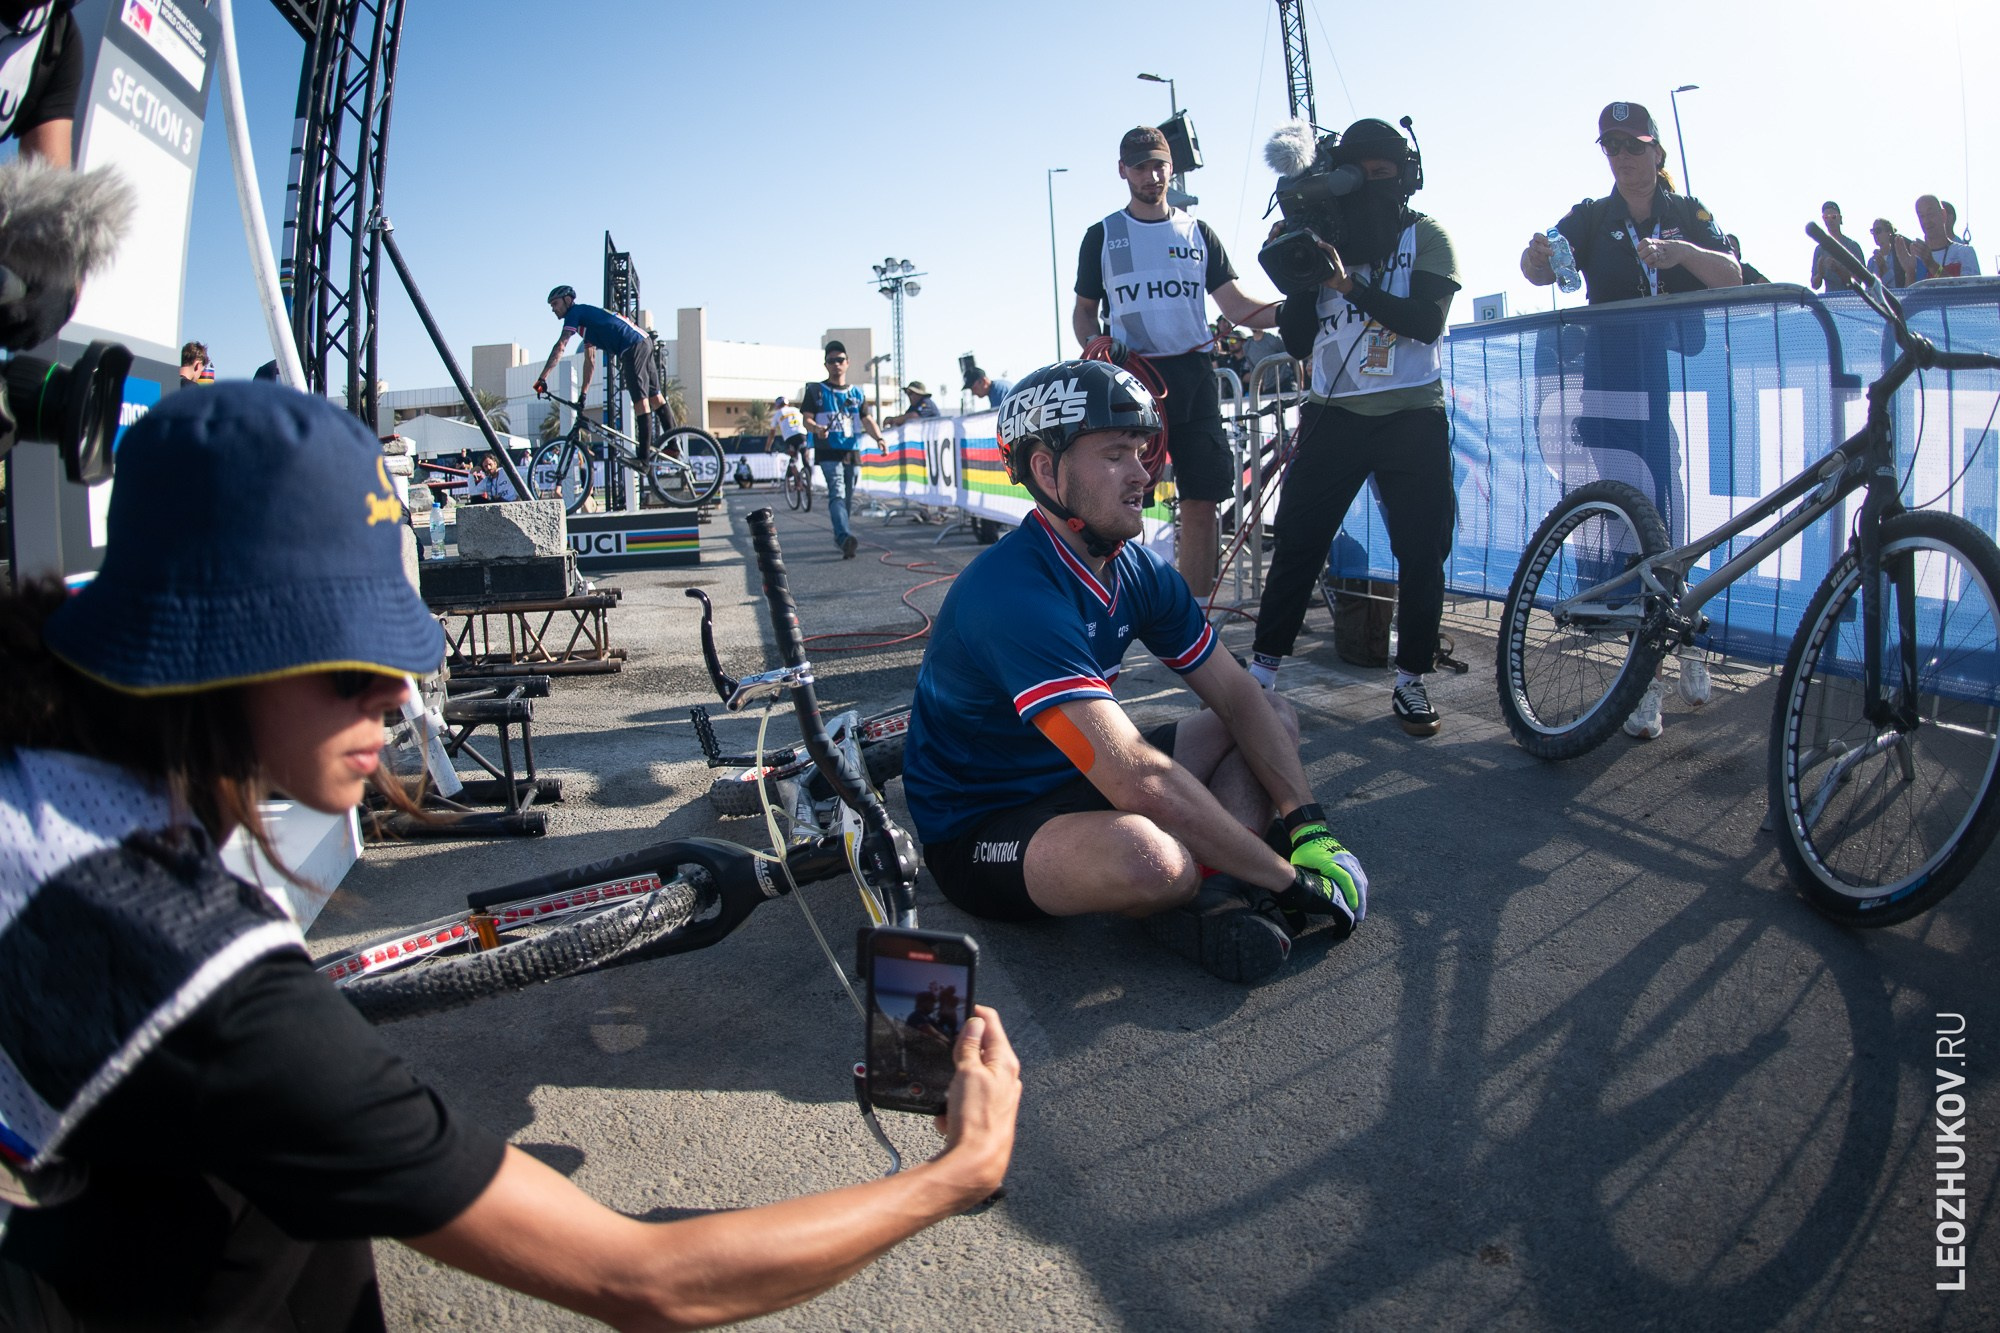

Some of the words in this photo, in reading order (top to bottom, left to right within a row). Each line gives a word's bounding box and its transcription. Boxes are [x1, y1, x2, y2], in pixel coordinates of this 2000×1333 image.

[108, 67, 183, 148] SECTION
[182, 126, 193, 155] 3
[1108, 238, 1130, 250] 323
[1175, 246, 1204, 262] UCI
[1115, 282, 1140, 304] TV
[1146, 279, 1200, 300] HOST
[1002, 377, 1089, 422] TRIAL
[1002, 398, 1087, 446] BIKES
[927, 437, 958, 488] UCI
[574, 532, 622, 554] UCI
[980, 840, 1020, 863] CONTROL
